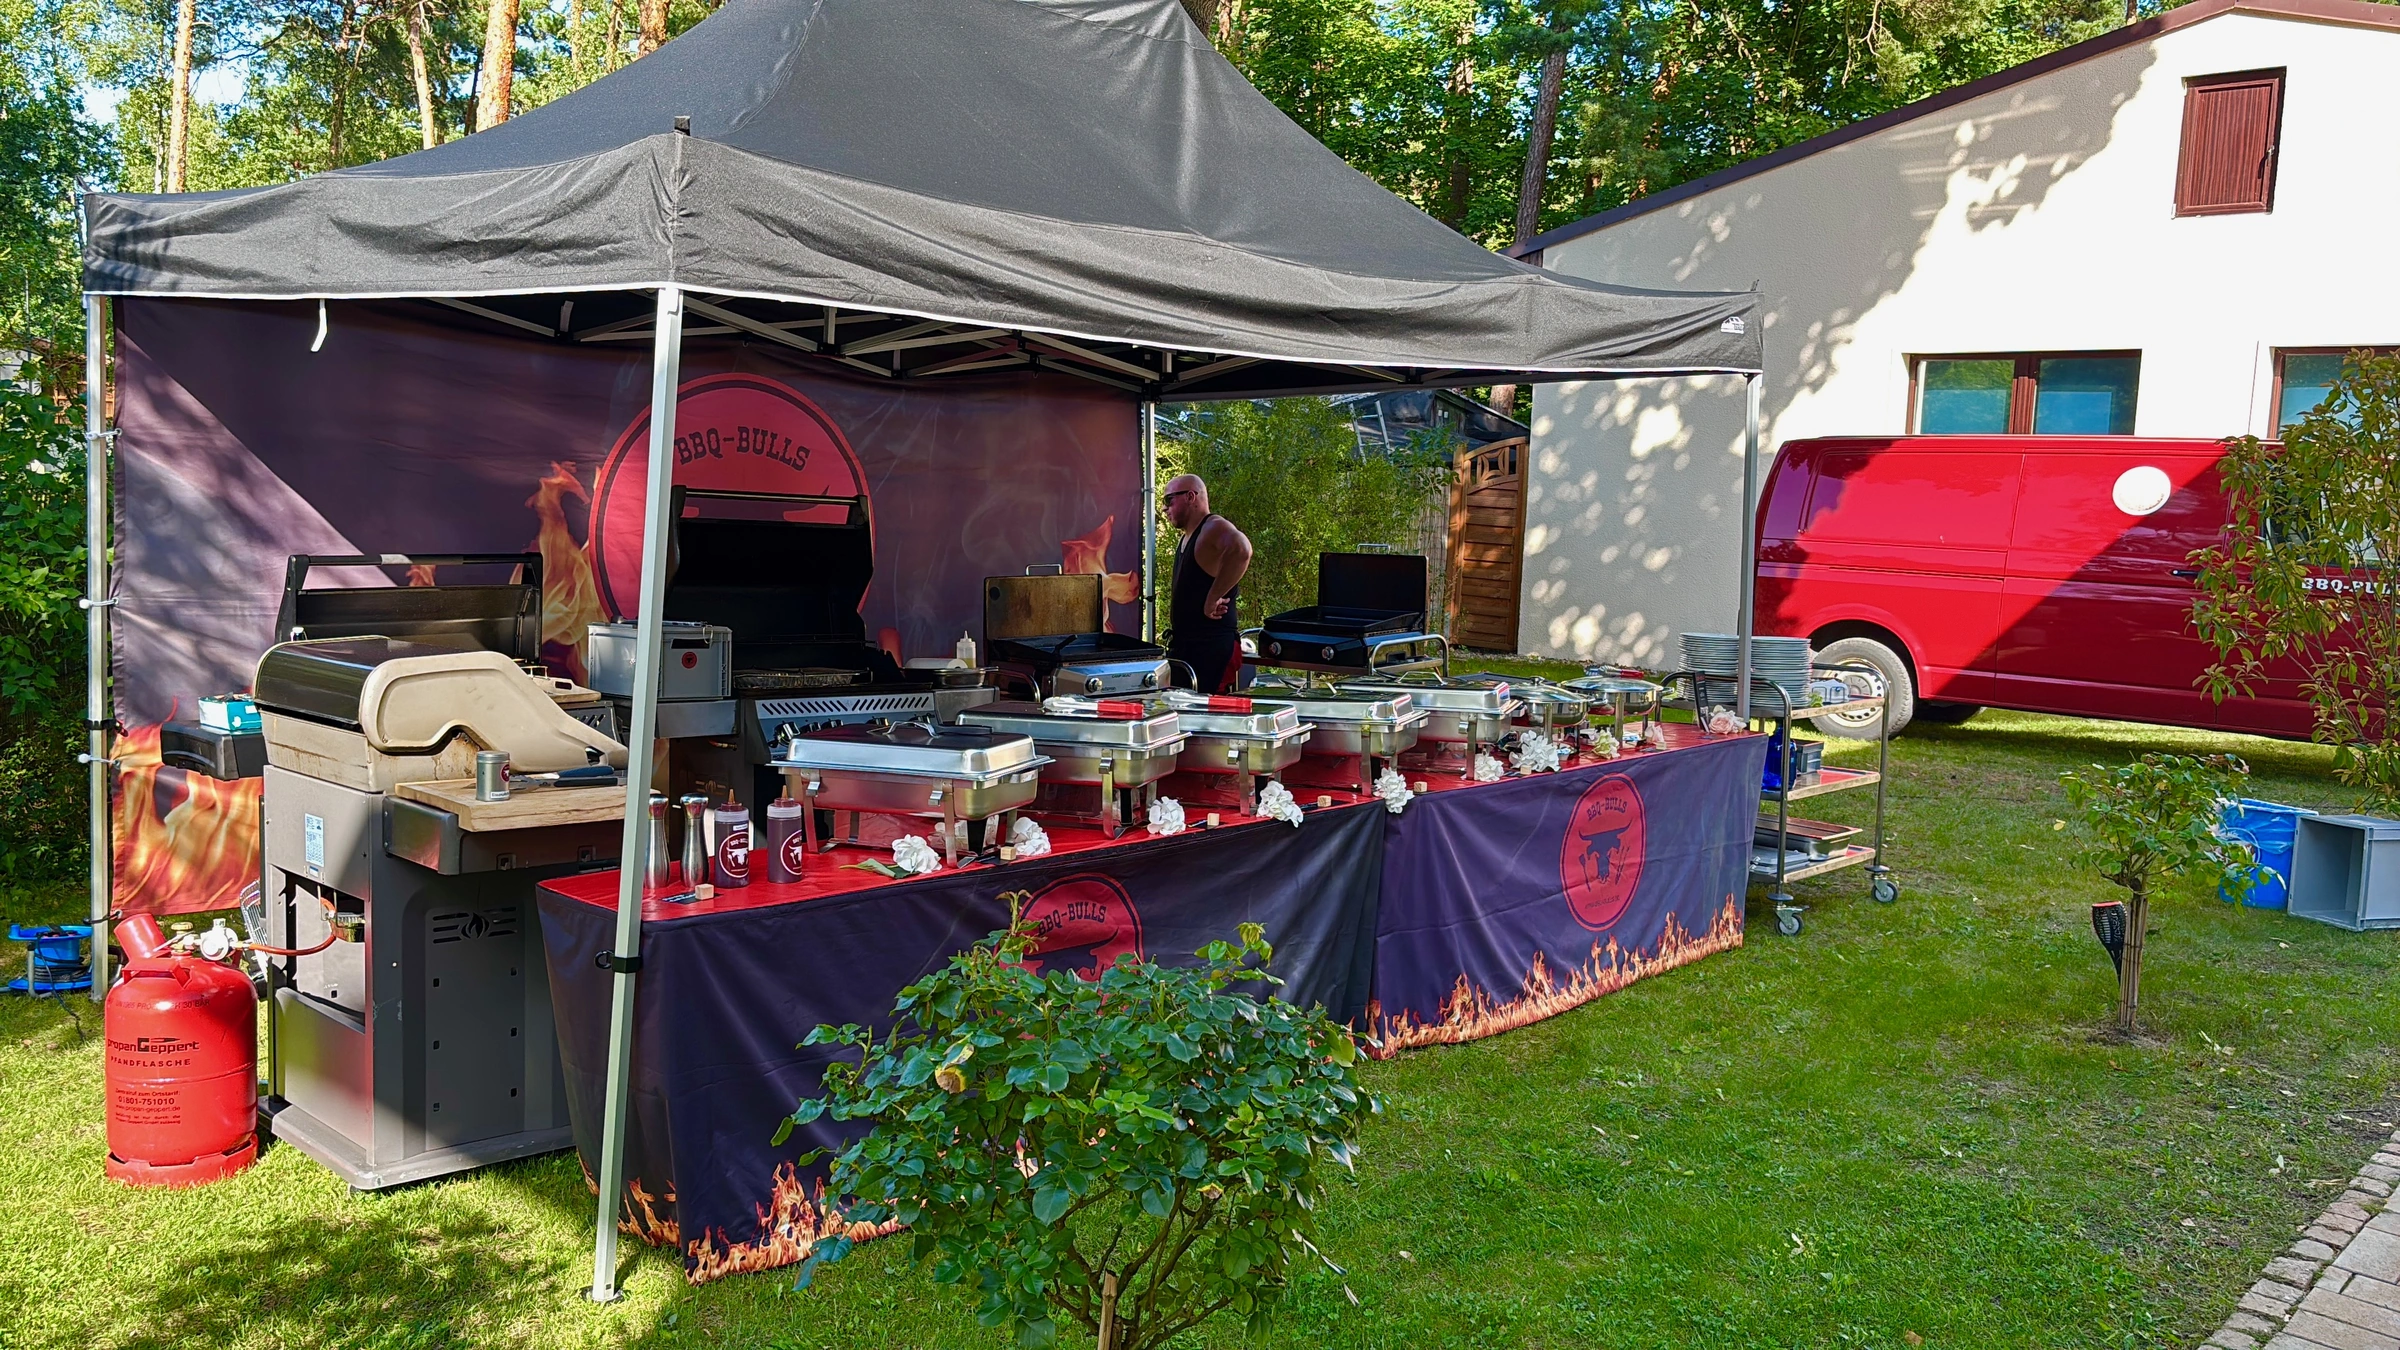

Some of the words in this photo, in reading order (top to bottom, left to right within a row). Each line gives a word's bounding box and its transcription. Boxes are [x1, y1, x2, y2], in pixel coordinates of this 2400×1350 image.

[673, 426, 811, 472] BBQ-BULLS
[1586, 797, 1628, 821] BBQ-BULLS
[1037, 901, 1107, 937] BBQ-BULLS
[110, 1055, 191, 1067] PFANDFLASCHE
